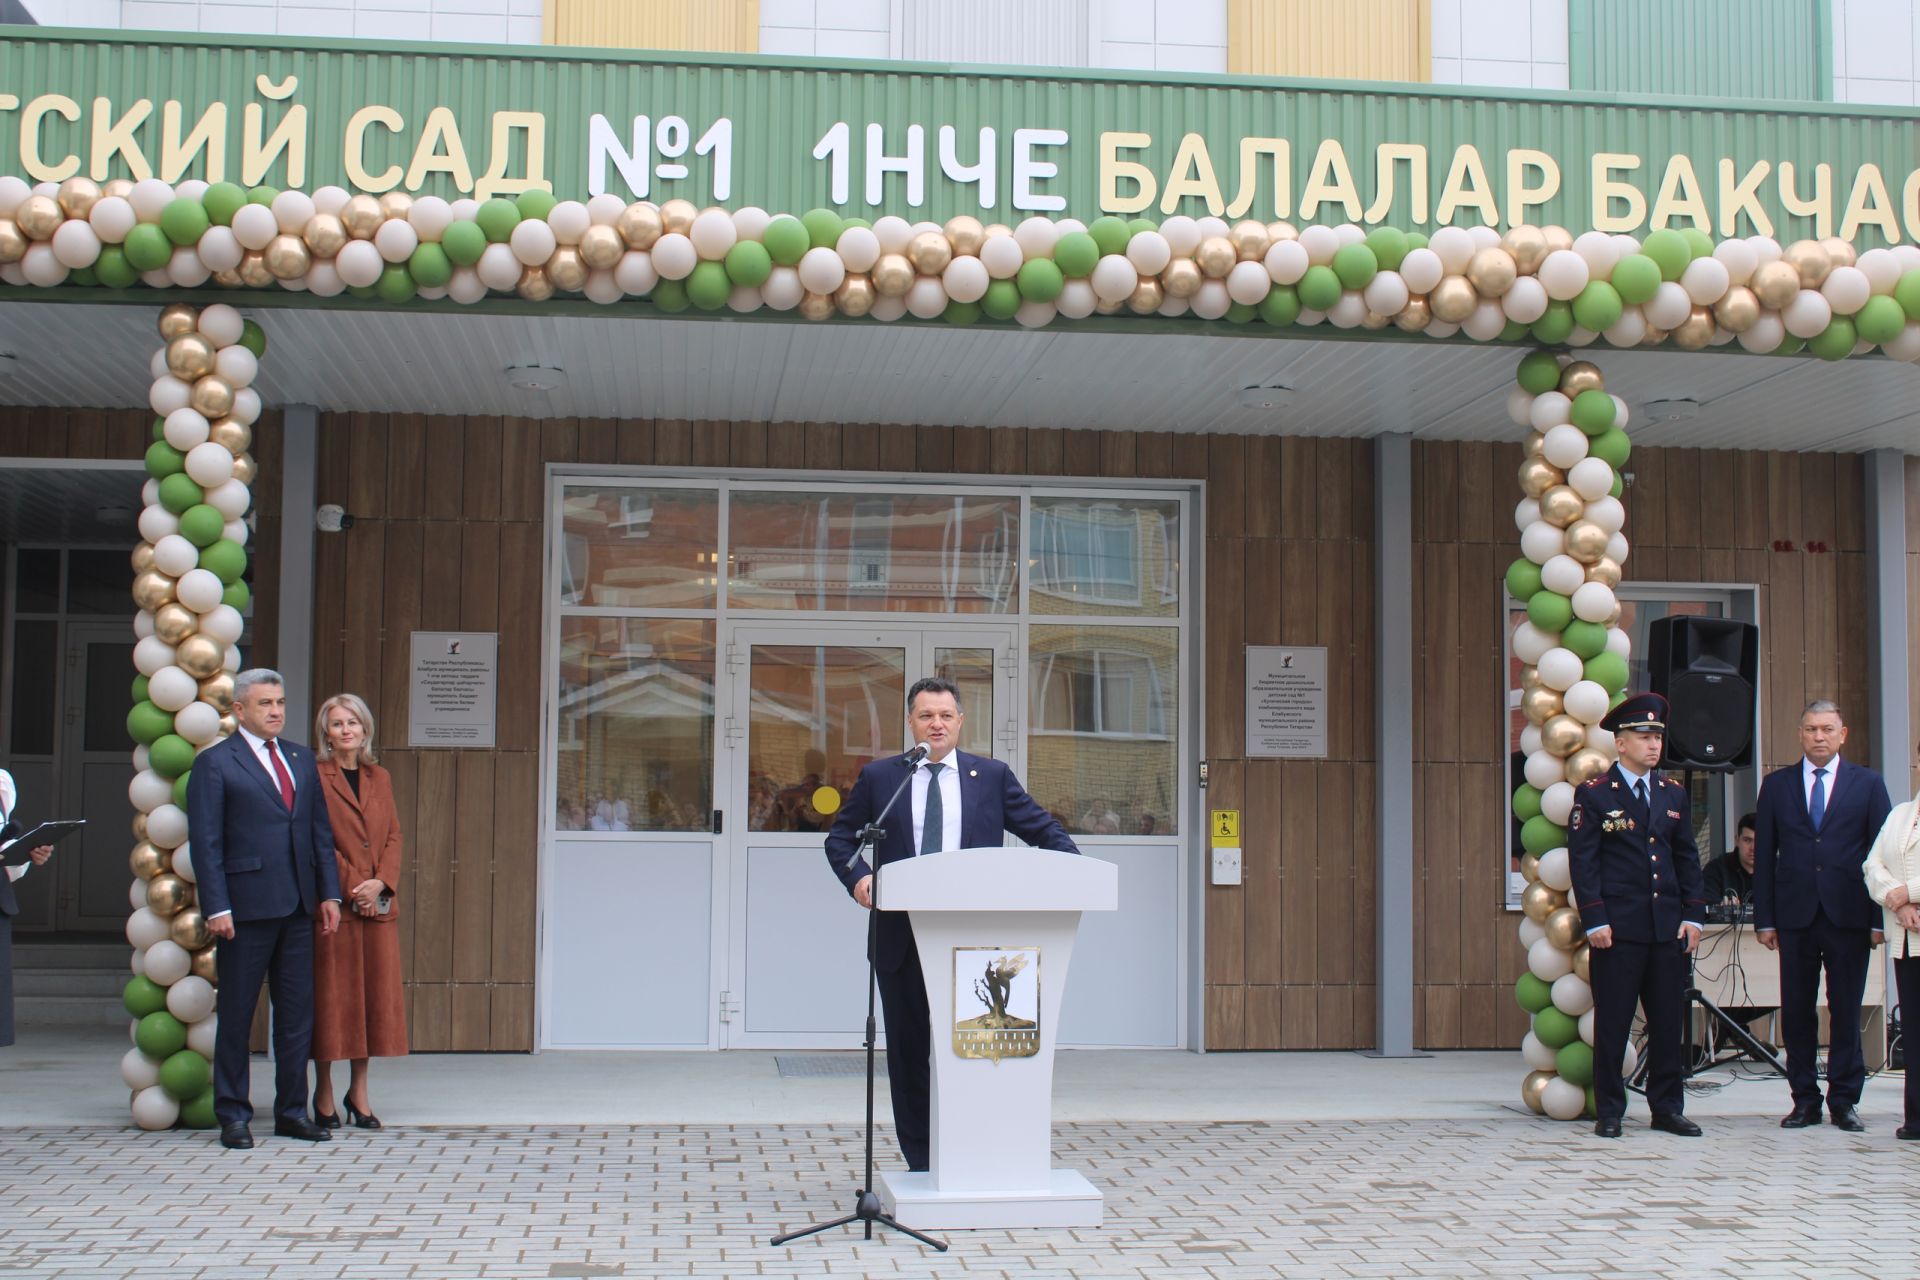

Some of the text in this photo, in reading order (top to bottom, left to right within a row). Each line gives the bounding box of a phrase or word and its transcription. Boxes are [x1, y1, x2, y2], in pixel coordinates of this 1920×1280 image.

[344, 106, 553, 202] САД
[588, 113, 732, 202] №1
[812, 121, 1920, 246] 1НЧЕ БАЛАЛАР БАКЧА
